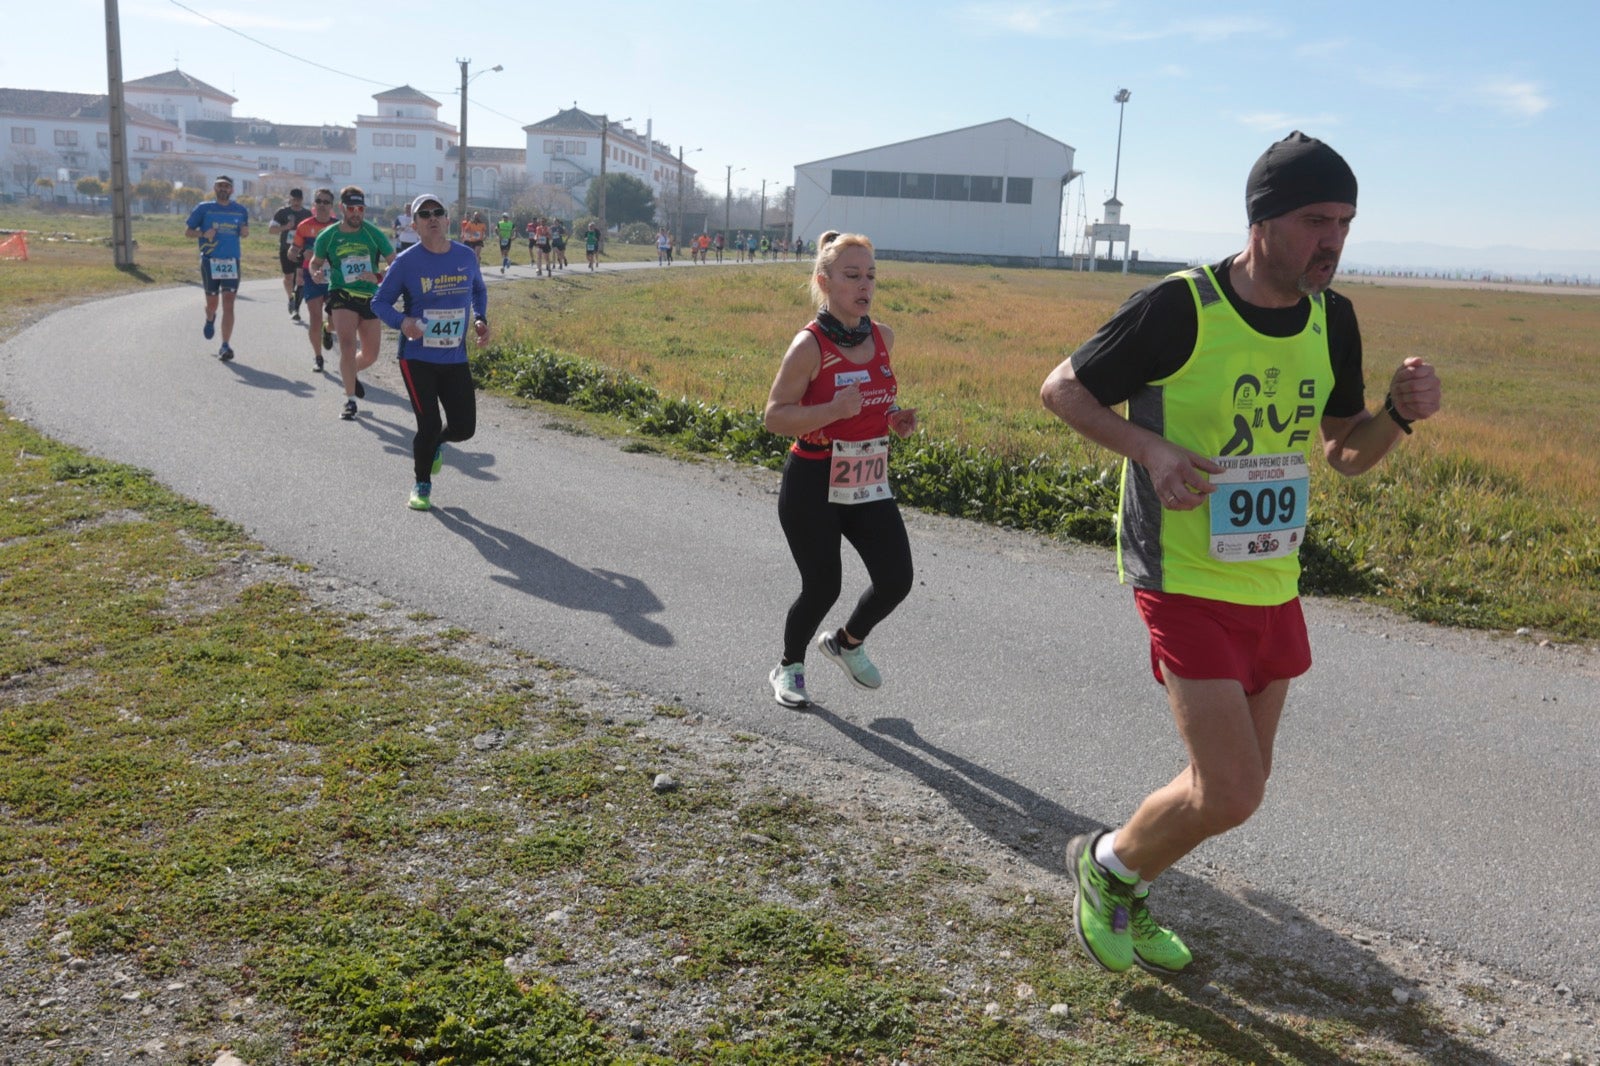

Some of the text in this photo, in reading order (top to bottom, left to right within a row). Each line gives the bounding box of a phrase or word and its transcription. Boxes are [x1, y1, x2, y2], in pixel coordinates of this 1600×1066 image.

[215, 264, 233, 273] 422
[346, 264, 366, 275] 282
[431, 321, 461, 336] 447
[1239, 458, 1258, 469] GRAN
[1259, 456, 1282, 467] PREMIO
[1282, 456, 1290, 465] DE
[834, 457, 885, 484] 2170
[1229, 486, 1295, 527] 909
